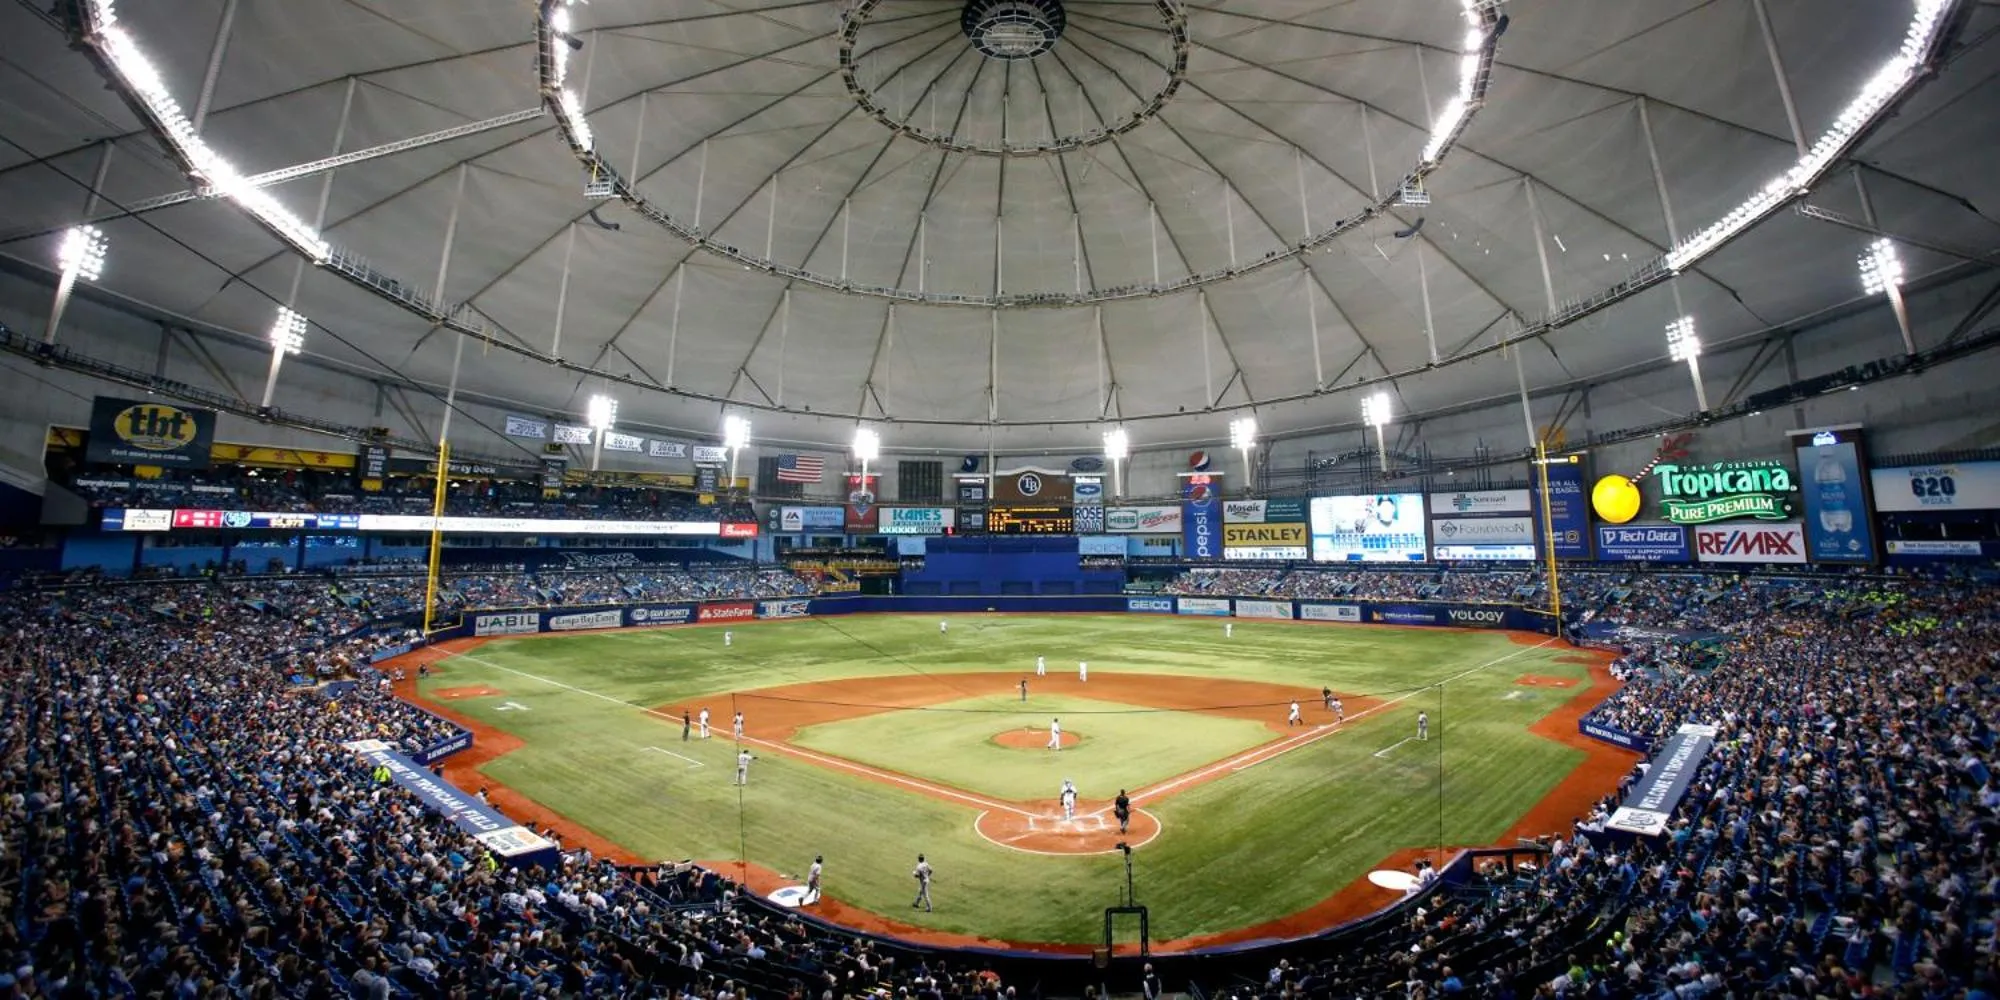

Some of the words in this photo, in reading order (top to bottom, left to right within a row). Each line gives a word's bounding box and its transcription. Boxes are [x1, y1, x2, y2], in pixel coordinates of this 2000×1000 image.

[1653, 464, 1790, 498] Tropicana
[1911, 476, 1956, 498] 620
[1075, 507, 1102, 519] ROSE
[1226, 502, 1261, 513] Mosaic
[1670, 506, 1707, 520] PURE
[1708, 498, 1774, 517] PREMIUM
[1109, 515, 1136, 525] HESS
[1194, 511, 1211, 557] pepsi
[1227, 528, 1302, 541] STANLEY
[1619, 530, 1645, 542] Tech
[1646, 530, 1677, 542] Data
[1697, 530, 1799, 556] RE/MAX
[1128, 599, 1172, 610] GEICO
[477, 615, 539, 629] JABIL
[1448, 609, 1504, 623] VOLOGY
[370, 751, 411, 772] WELCOME
[413, 778, 469, 810] TROPICANA
[461, 809, 500, 830] FIELD
